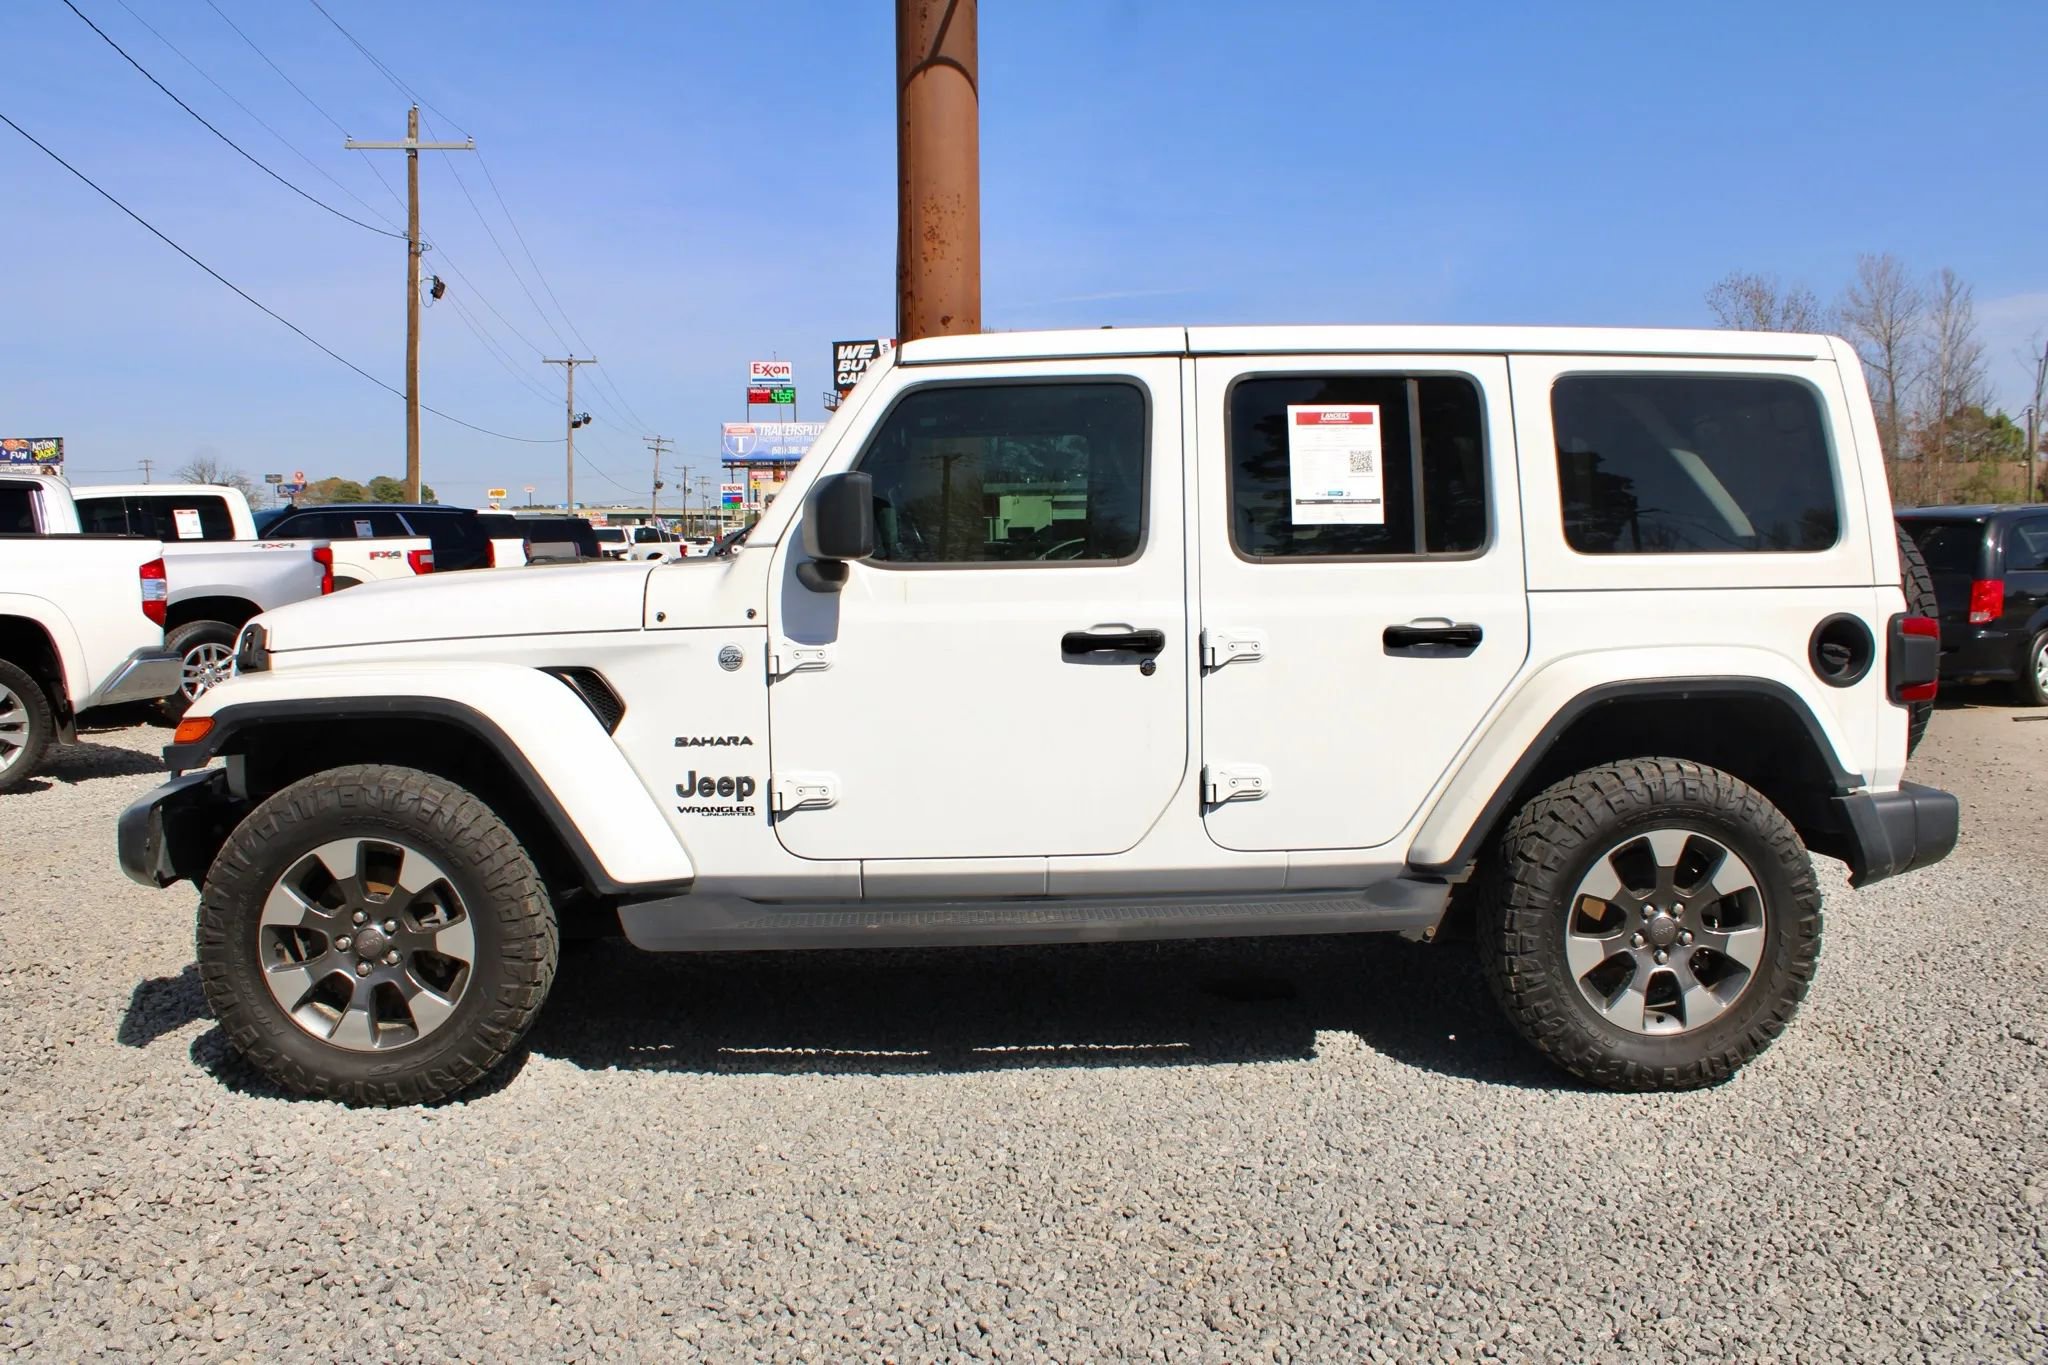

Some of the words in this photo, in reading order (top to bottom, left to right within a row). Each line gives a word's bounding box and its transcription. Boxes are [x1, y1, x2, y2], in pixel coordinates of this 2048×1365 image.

[838, 344, 876, 360] WE
[753, 363, 790, 378] Exxon
[838, 359, 876, 372] BUY
[1320, 412, 1351, 421] LANDERS
[10, 451, 28, 460] FUN
[369, 550, 402, 561] FX4
[674, 735, 754, 748] SAHARA
[675, 770, 756, 802] Jeep
[677, 805, 755, 814] WRANGLER
